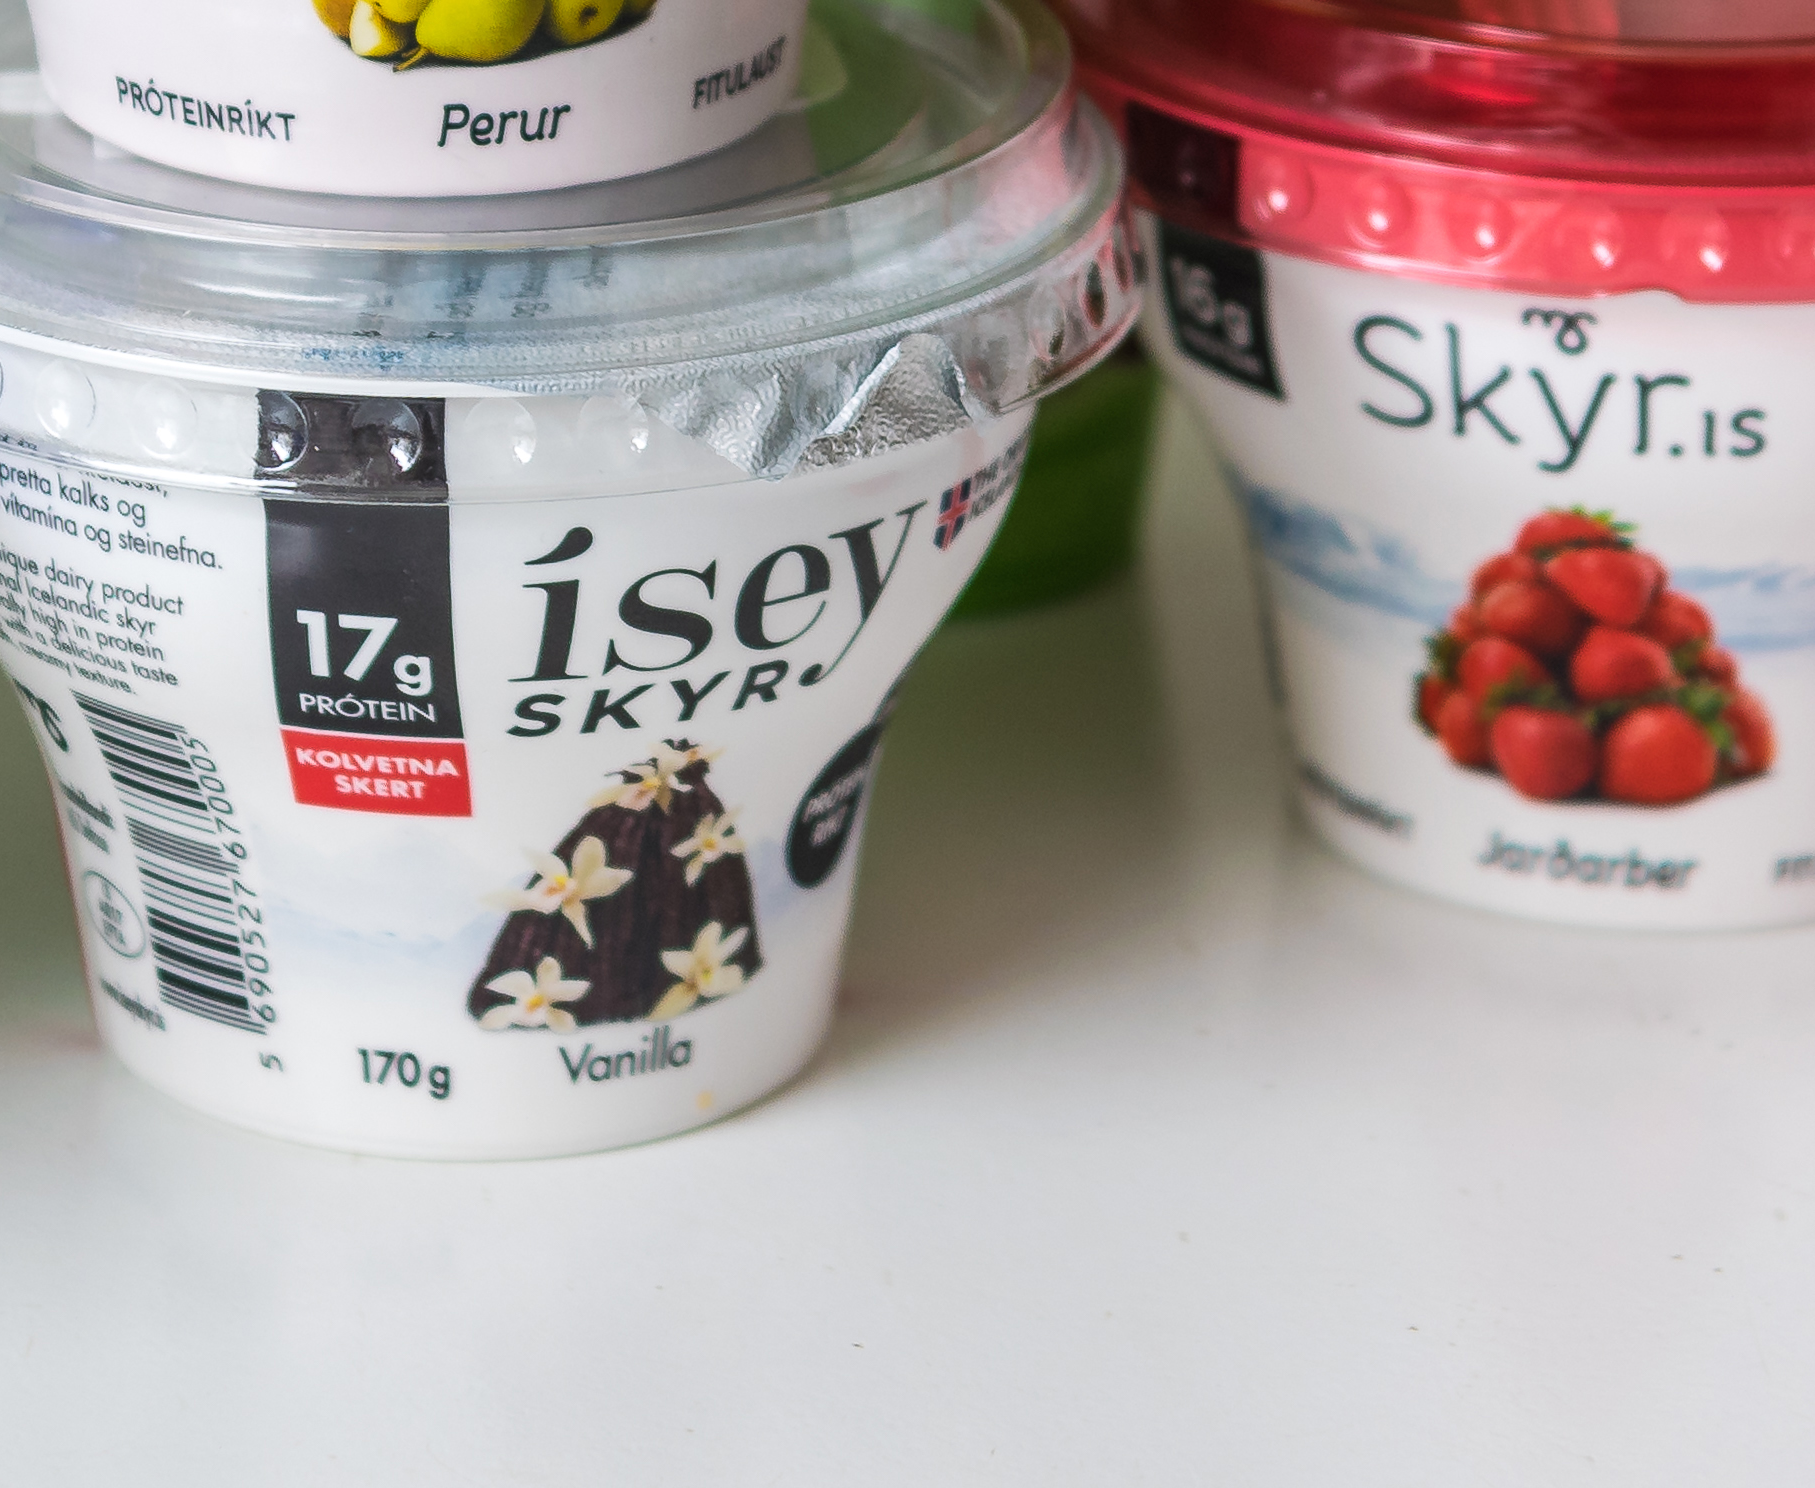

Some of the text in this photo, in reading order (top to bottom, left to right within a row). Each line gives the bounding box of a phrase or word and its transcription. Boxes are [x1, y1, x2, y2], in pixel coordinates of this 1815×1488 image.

[692, 37, 787, 110] FITULAUST
[116, 75, 295, 142] PRÓTEINRÍKT
[438, 102, 573, 148] Perur
[58, 474, 110, 513] kalks
[117, 500, 146, 528] og
[0, 492, 78, 538] vítamína
[85, 525, 112, 553] og
[119, 535, 223, 571] steinefna.
[25, 576, 109, 624] Icelandic
[117, 608, 157, 638] skyr
[44, 558, 94, 598] dairy
[102, 583, 185, 616] product
[29, 601, 69, 636] high
[74, 619, 90, 642] in
[95, 628, 165, 663] protein
[51, 631, 128, 674] delicious
[131, 660, 180, 687] taste
[296, 609, 434, 696] 17g
[74, 660, 138, 695] texture.
[507, 659, 789, 739] SKYR
[298, 692, 436, 723] PRÓTEIN
[295, 746, 459, 779] KOLVETNA
[334, 775, 426, 800] SKERT
[1477, 830, 1699, 893] Jarðarber
[558, 1026, 693, 1085] Vanilla
